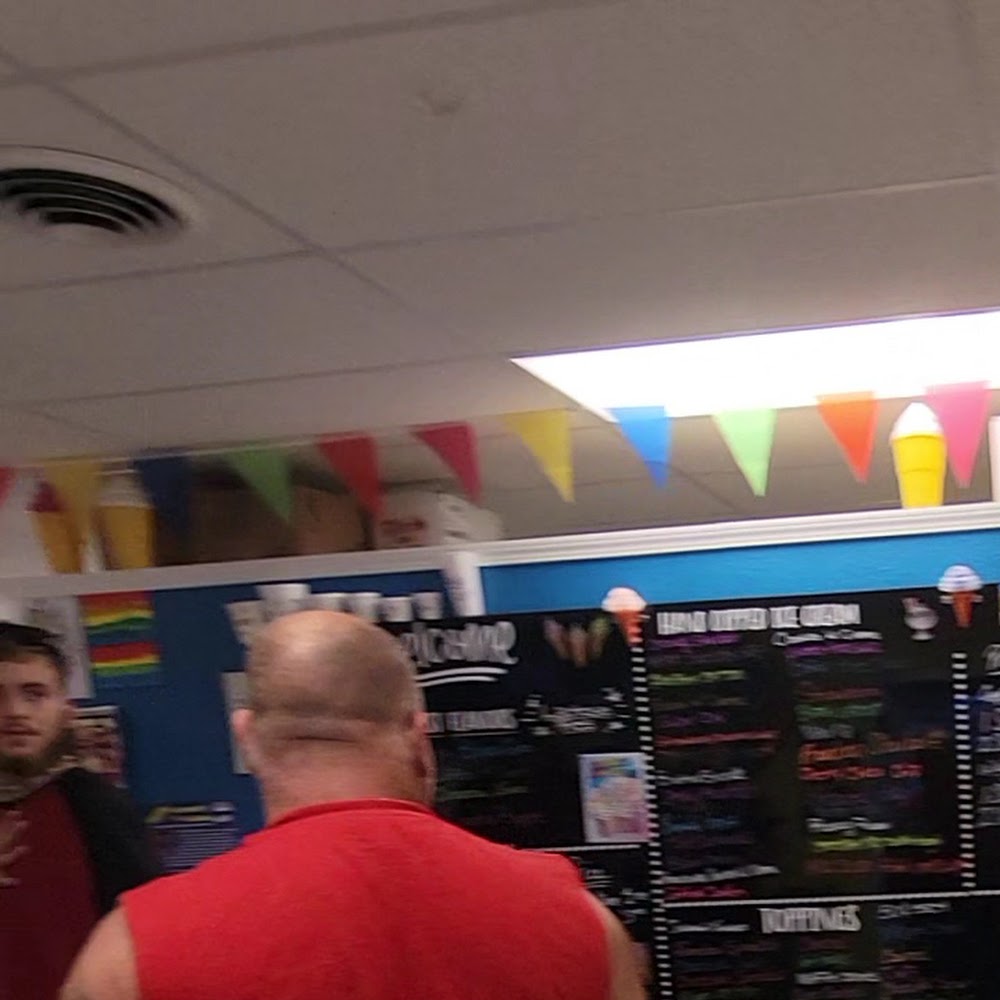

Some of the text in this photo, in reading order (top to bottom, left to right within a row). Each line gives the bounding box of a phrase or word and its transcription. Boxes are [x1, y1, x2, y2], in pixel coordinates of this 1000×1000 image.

[769, 605, 799, 628] ICE
[800, 603, 861, 627] CREAM
[759, 904, 862, 934] TOPPINGS
